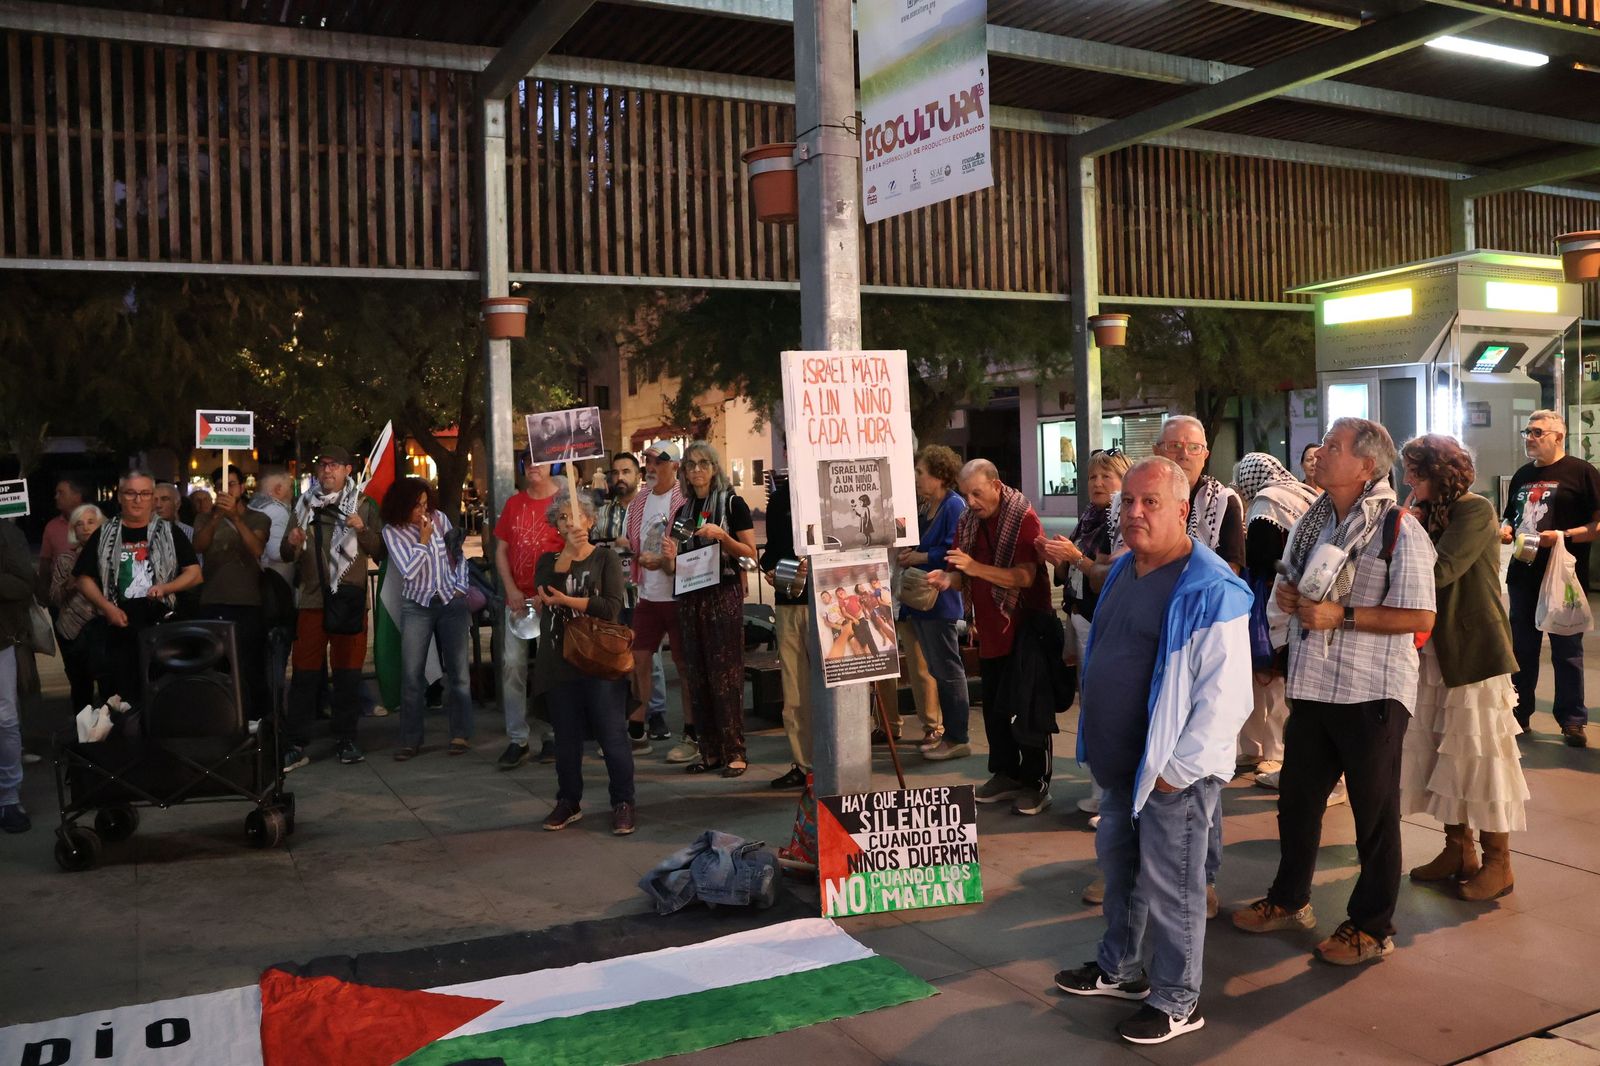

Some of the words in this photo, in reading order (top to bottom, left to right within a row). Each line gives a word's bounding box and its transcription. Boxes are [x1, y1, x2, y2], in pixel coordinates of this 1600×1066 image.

[865, 85, 984, 162] ECOCULTURA
[865, 162, 882, 173] FERIA
[913, 147, 921, 155] DE
[921, 136, 951, 152] PRODUCTOS
[952, 123, 985, 141] ECOLÓGICOS
[803, 356, 847, 385] ISRAEL
[851, 357, 891, 383] MATA
[802, 389, 814, 416] A
[819, 387, 840, 416] UN
[853, 383, 892, 415] NIÑO
[808, 417, 851, 445] CADA
[857, 417, 896, 445] HORA
[831, 464, 858, 475] ISRAEL
[859, 464, 879, 473] MATA
[835, 475, 842, 484] A
[843, 475, 853, 483] UN
[855, 472, 873, 483] NIÑO
[833, 484, 854, 494] CADA
[856, 482, 879, 492] HORA.
[841, 793, 869, 814] HAY
[873, 791, 898, 809] QUE
[904, 787, 950, 807] HACER
[859, 803, 961, 834] SILENCIO
[868, 831, 932, 850] CUANDO
[938, 825, 967, 844] LOS
[908, 842, 979, 869] DUERMEN
[870, 867, 935, 888] CUANDO
[940, 864, 971, 882] LOS
[825, 875, 868, 916] NO
[881, 881, 966, 911] MATAN
